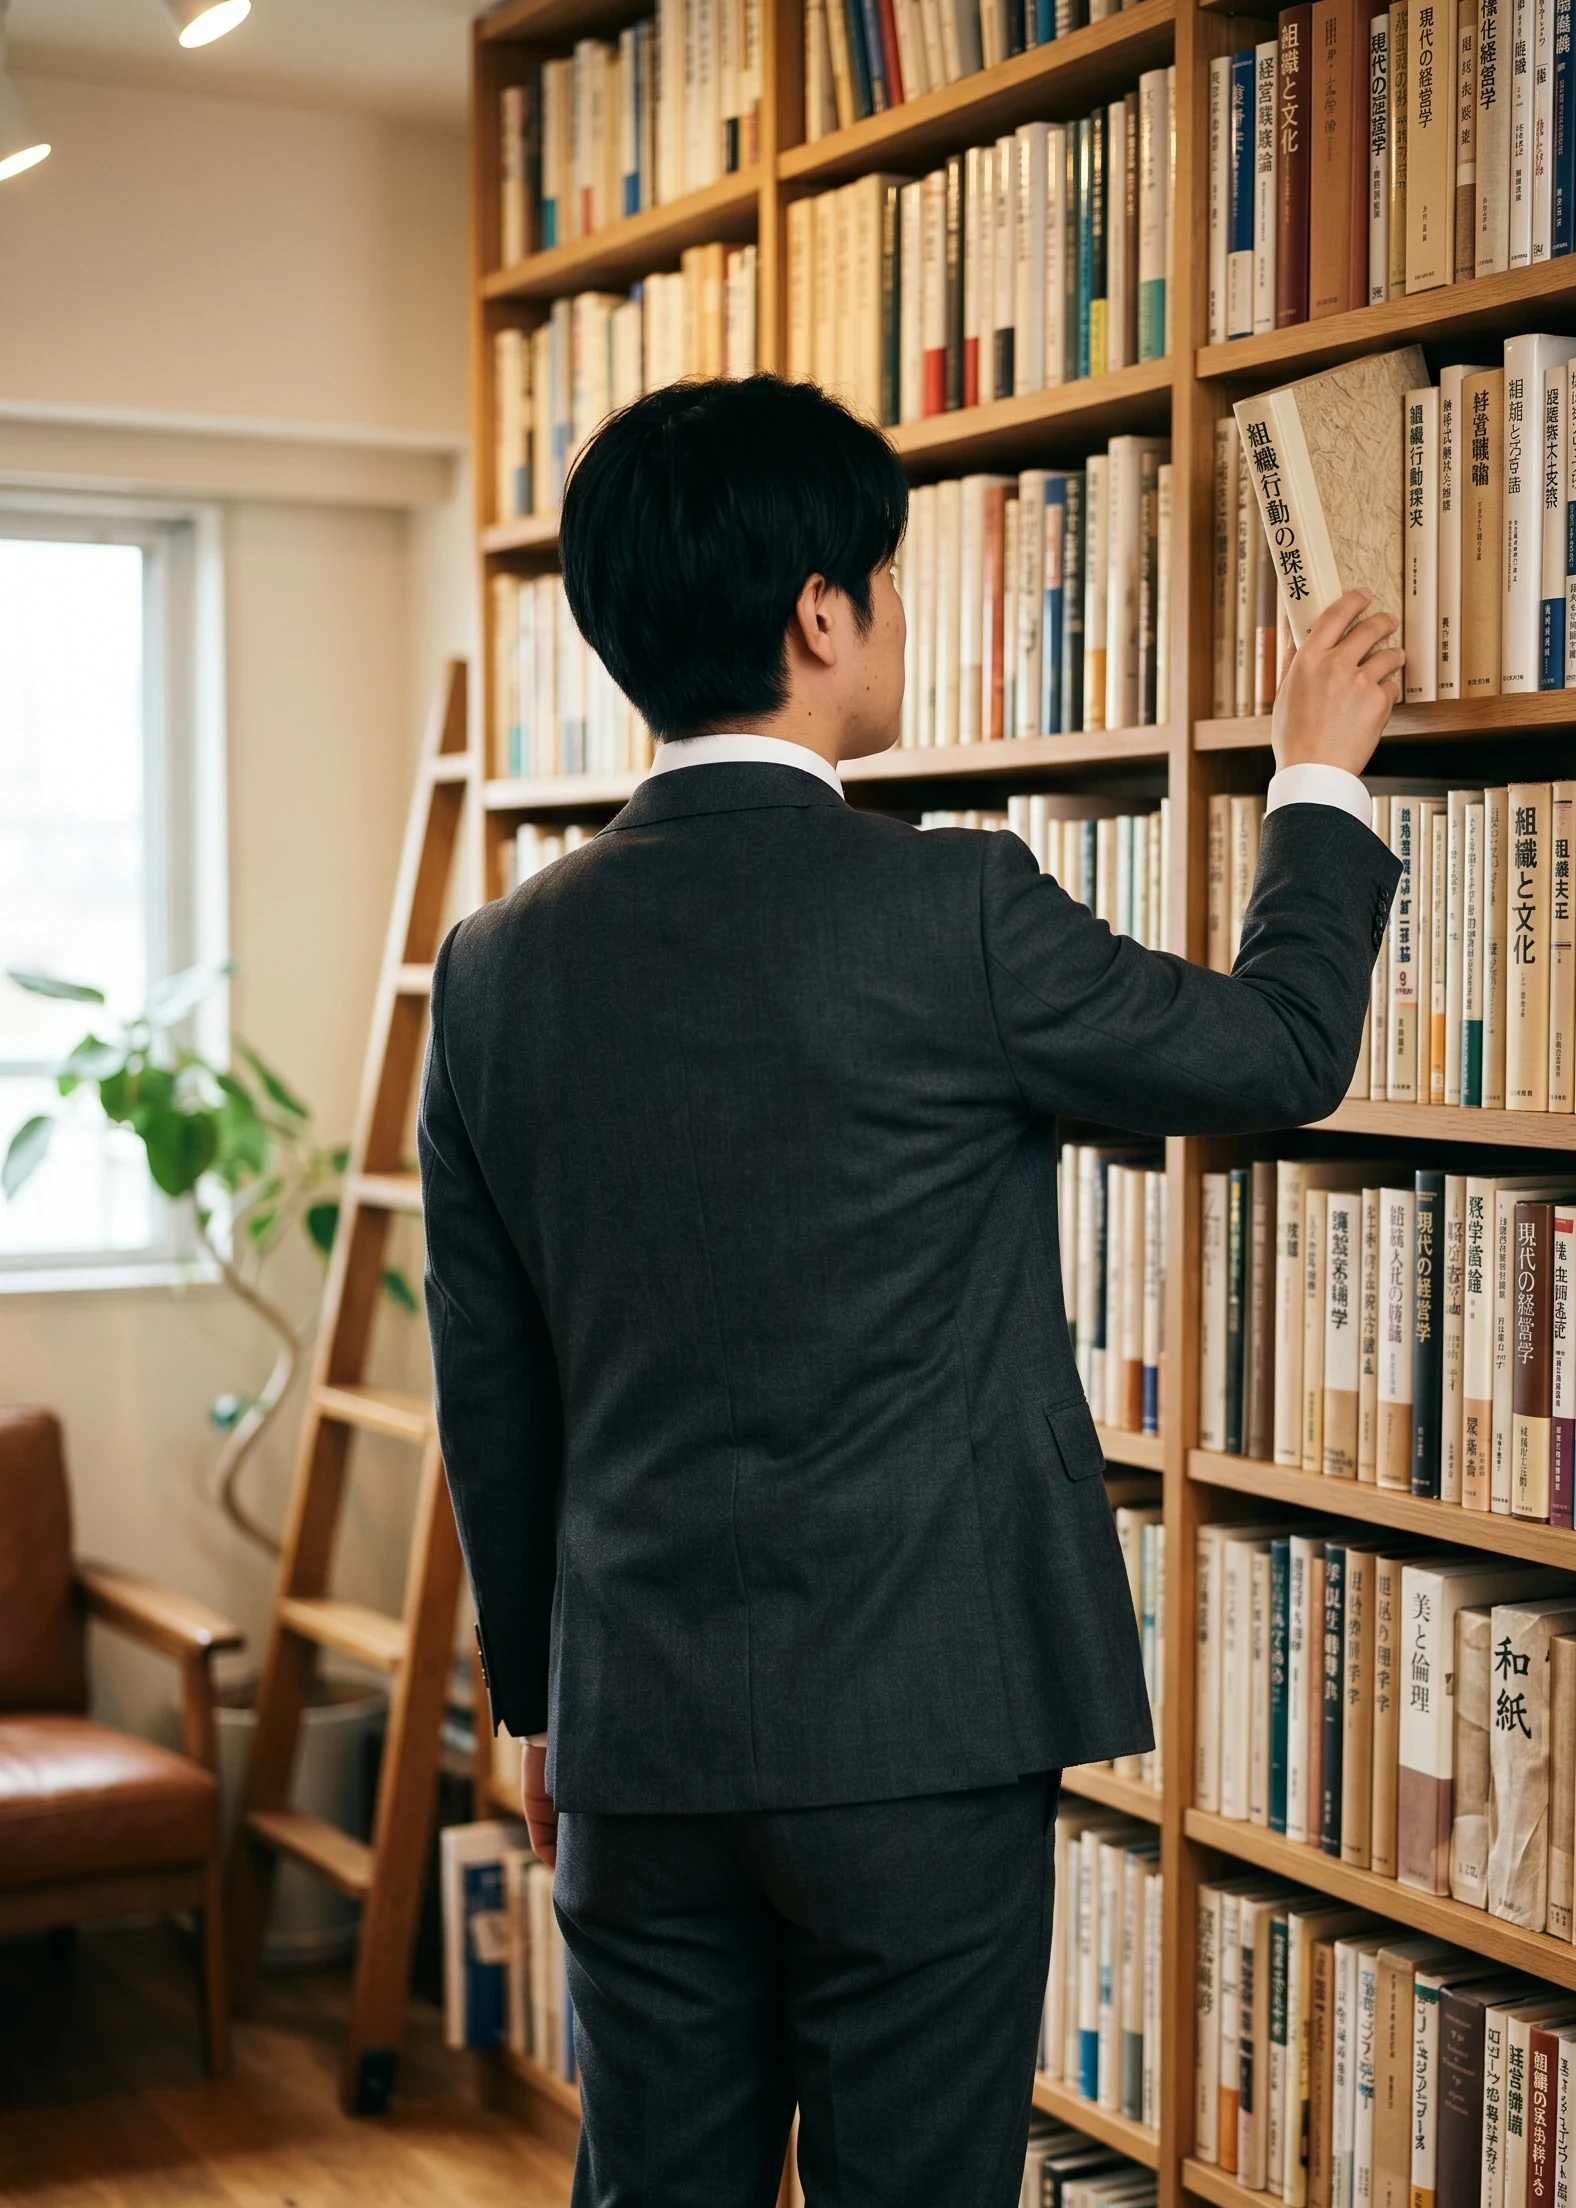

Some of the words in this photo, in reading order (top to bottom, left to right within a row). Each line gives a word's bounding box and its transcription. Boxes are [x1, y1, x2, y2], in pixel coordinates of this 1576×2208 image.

[1281, 23, 1299, 154] 組織と文化
[1419, 7, 1433, 128] 現代の経営学
[1246, 421, 1310, 600] 組織行動の探求
[1513, 807, 1538, 964] 組織と文化
[1416, 1211, 1434, 1343] 現代の経営学
[1410, 1592, 1431, 1714] 美と倫理
[1494, 1635, 1532, 1740] 和紙
